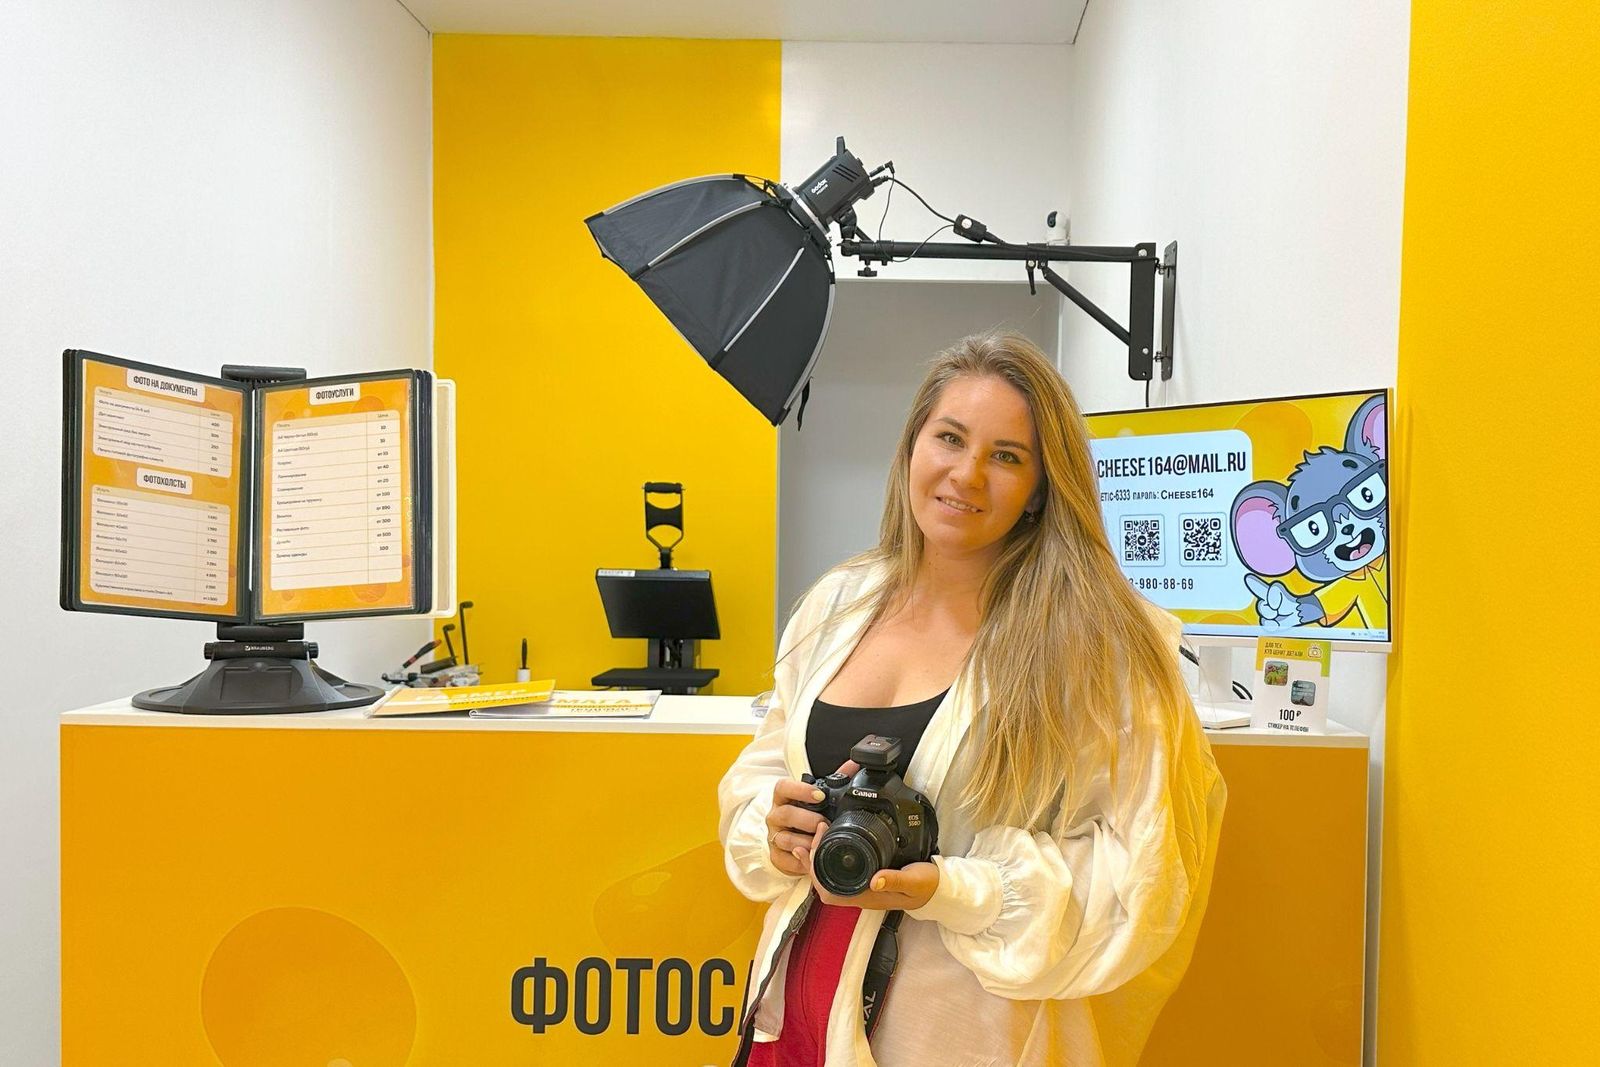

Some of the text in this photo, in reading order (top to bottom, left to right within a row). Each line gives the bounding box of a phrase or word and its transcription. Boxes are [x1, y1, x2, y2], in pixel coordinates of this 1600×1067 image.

[133, 375, 198, 397] ФОТО НА ДОКУМЕНТЫ
[315, 388, 354, 400] ФОТОУСЛУГИ
[143, 474, 187, 489] ФОТОХОЛСТЫ
[1279, 709, 1295, 721] 100
[852, 789, 878, 799] Canon
